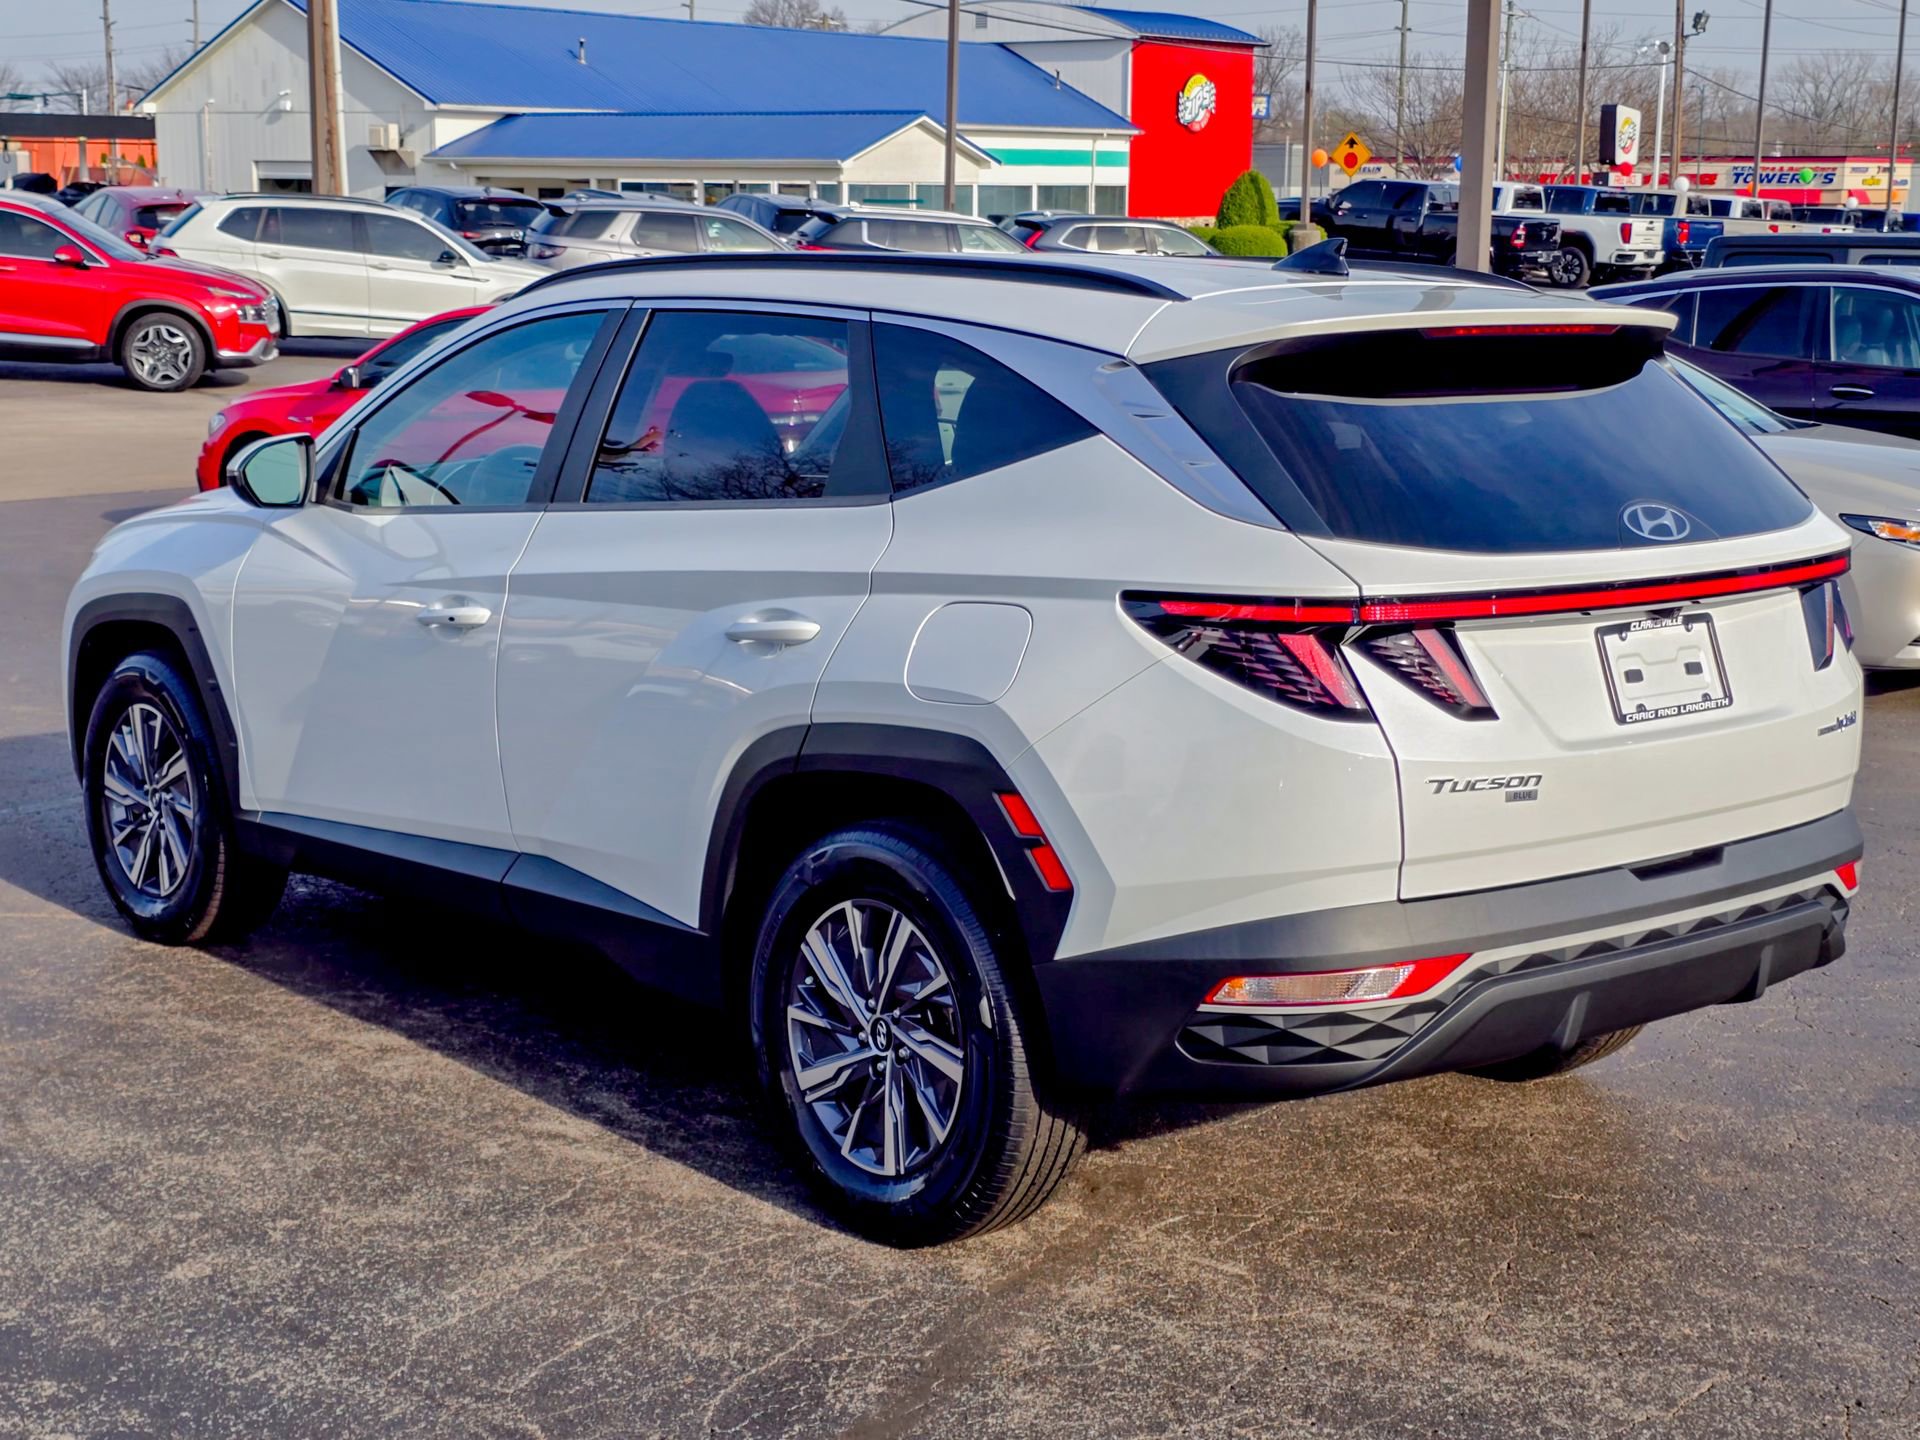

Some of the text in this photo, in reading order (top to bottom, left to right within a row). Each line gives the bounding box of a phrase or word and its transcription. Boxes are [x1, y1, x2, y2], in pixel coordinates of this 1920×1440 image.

[1630, 616, 1683, 631] CLARKSVILLE
[1625, 697, 1729, 723] CRAIG AND LANDRETH
[1513, 790, 1533, 800] BLUE
